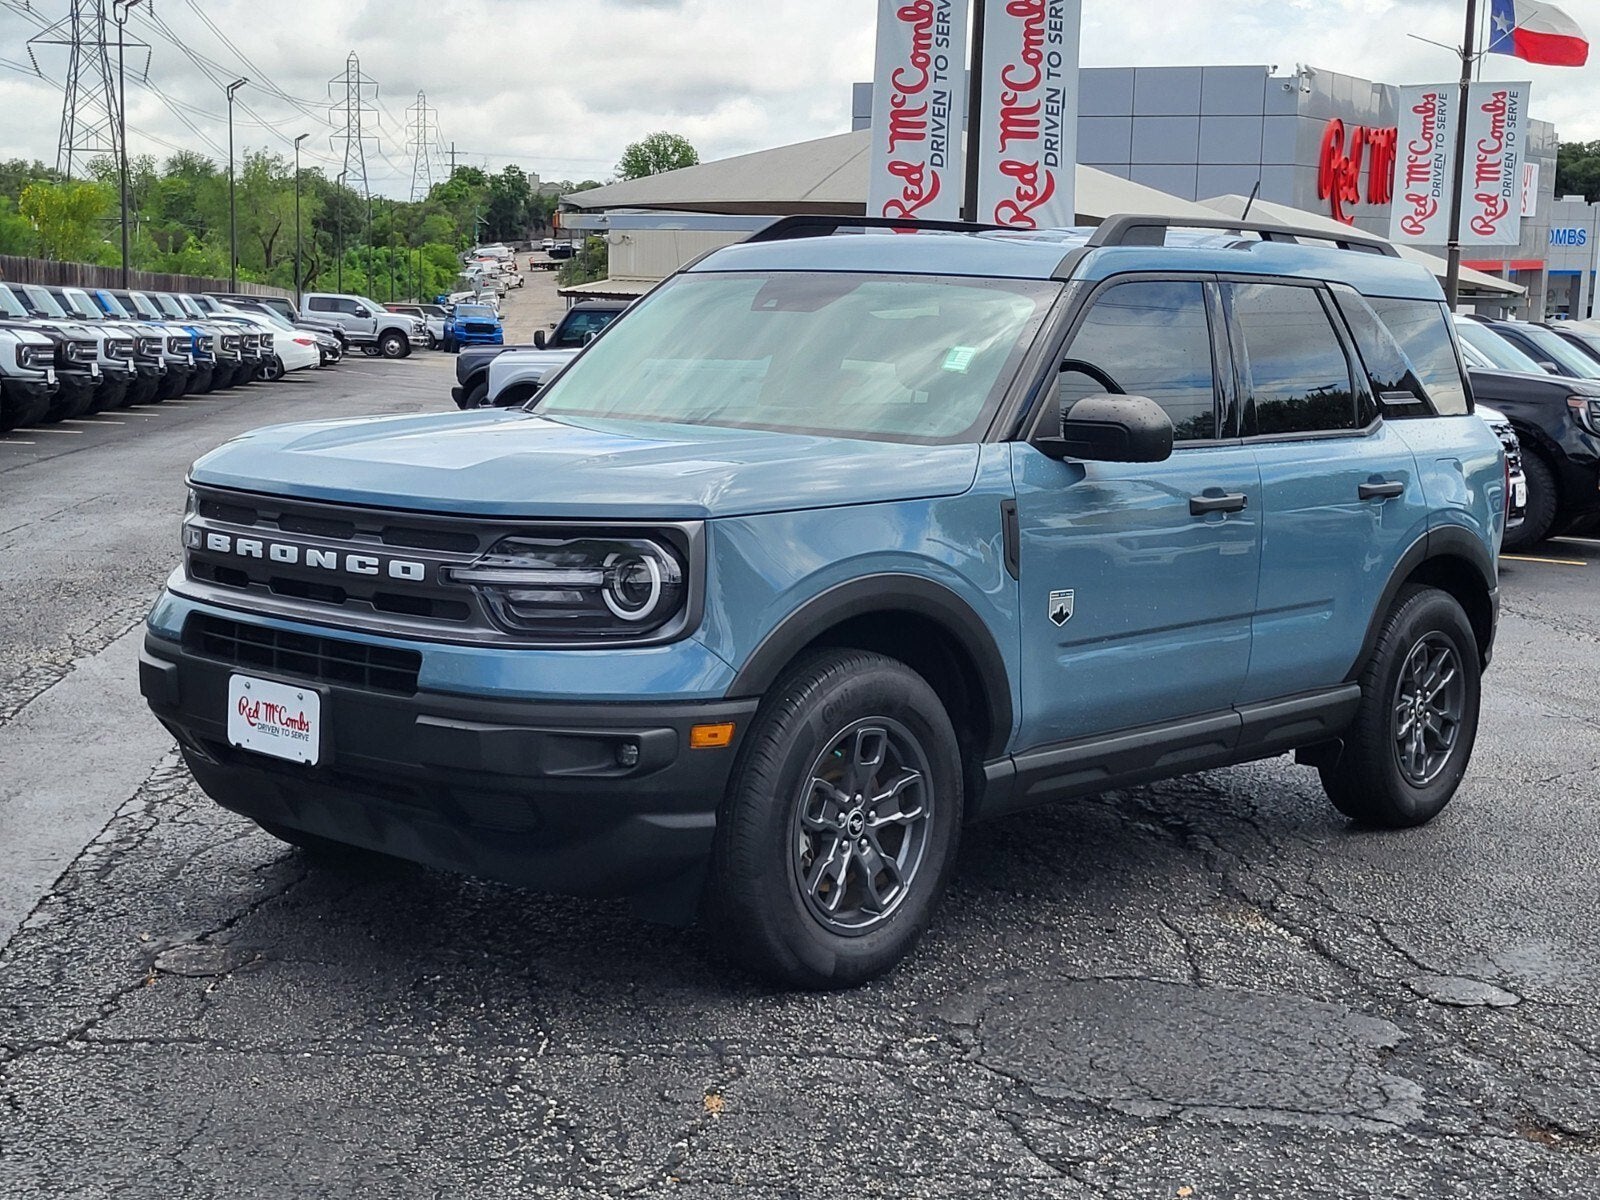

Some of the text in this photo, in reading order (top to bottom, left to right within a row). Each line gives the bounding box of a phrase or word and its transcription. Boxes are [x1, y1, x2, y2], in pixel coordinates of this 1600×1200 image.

[933, 55, 949, 83] TO
[1046, 52, 1062, 80] TO
[930, 89, 948, 168] DRIVEN
[1043, 87, 1061, 168] DRIVEN
[1400, 92, 1438, 236] Red McCombs
[1431, 92, 1448, 198] DRIVEN TO SERVE
[1470, 91, 1509, 236] Red McCombs
[1502, 90, 1519, 198] DRIVEN TO SERVE
[882, 160, 941, 233] Red
[993, 160, 1056, 229] Red
[207, 532, 426, 582] BRONCO
[238, 695, 310, 733] Red McCombs
[257, 722, 310, 742] DRIVEN TO SERVE
